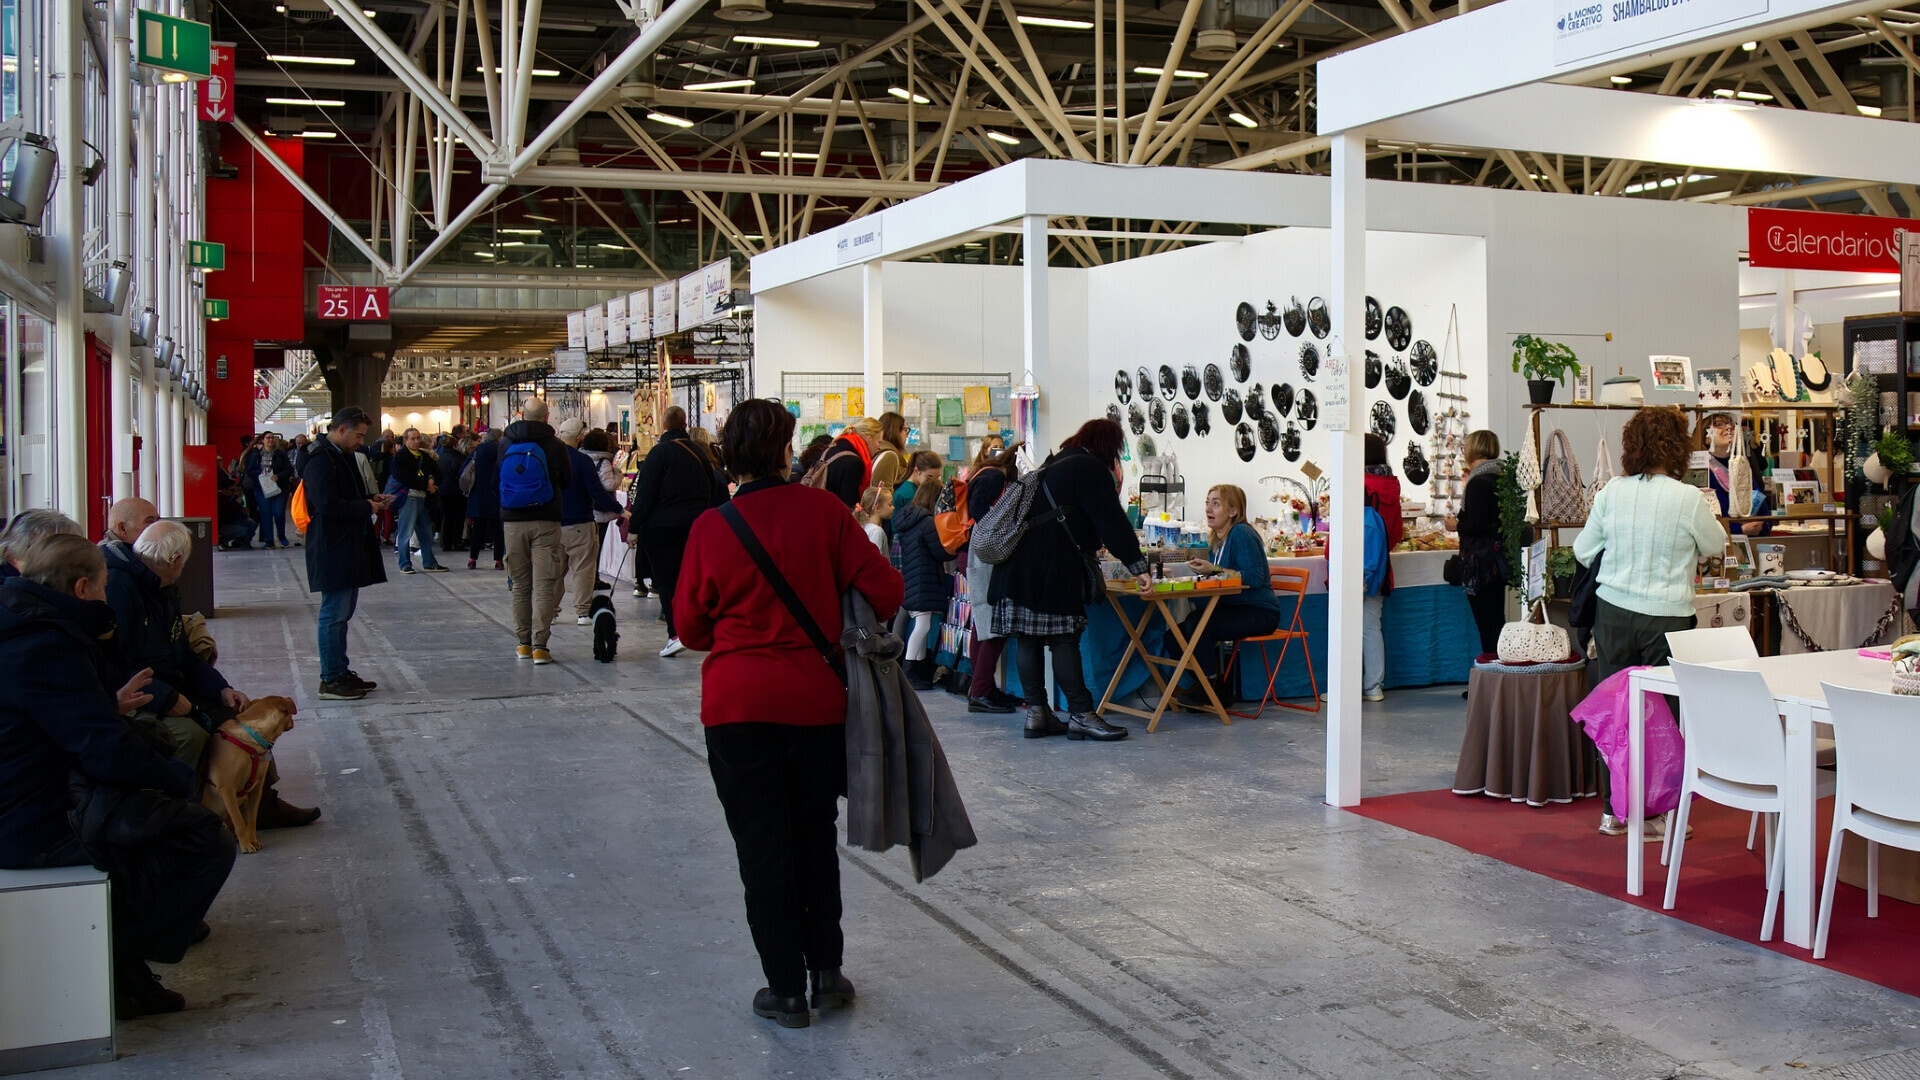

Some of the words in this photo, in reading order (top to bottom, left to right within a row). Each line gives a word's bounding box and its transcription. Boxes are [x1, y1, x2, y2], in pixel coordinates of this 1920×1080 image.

[1568, 12, 1573, 21] IL
[1574, 4, 1603, 19] MONDO
[1568, 14, 1603, 31] CREATIVO
[1767, 225, 1884, 258] Calendario
[324, 299, 349, 317] 25
[361, 293, 382, 318] A
[258, 388, 266, 398] A
